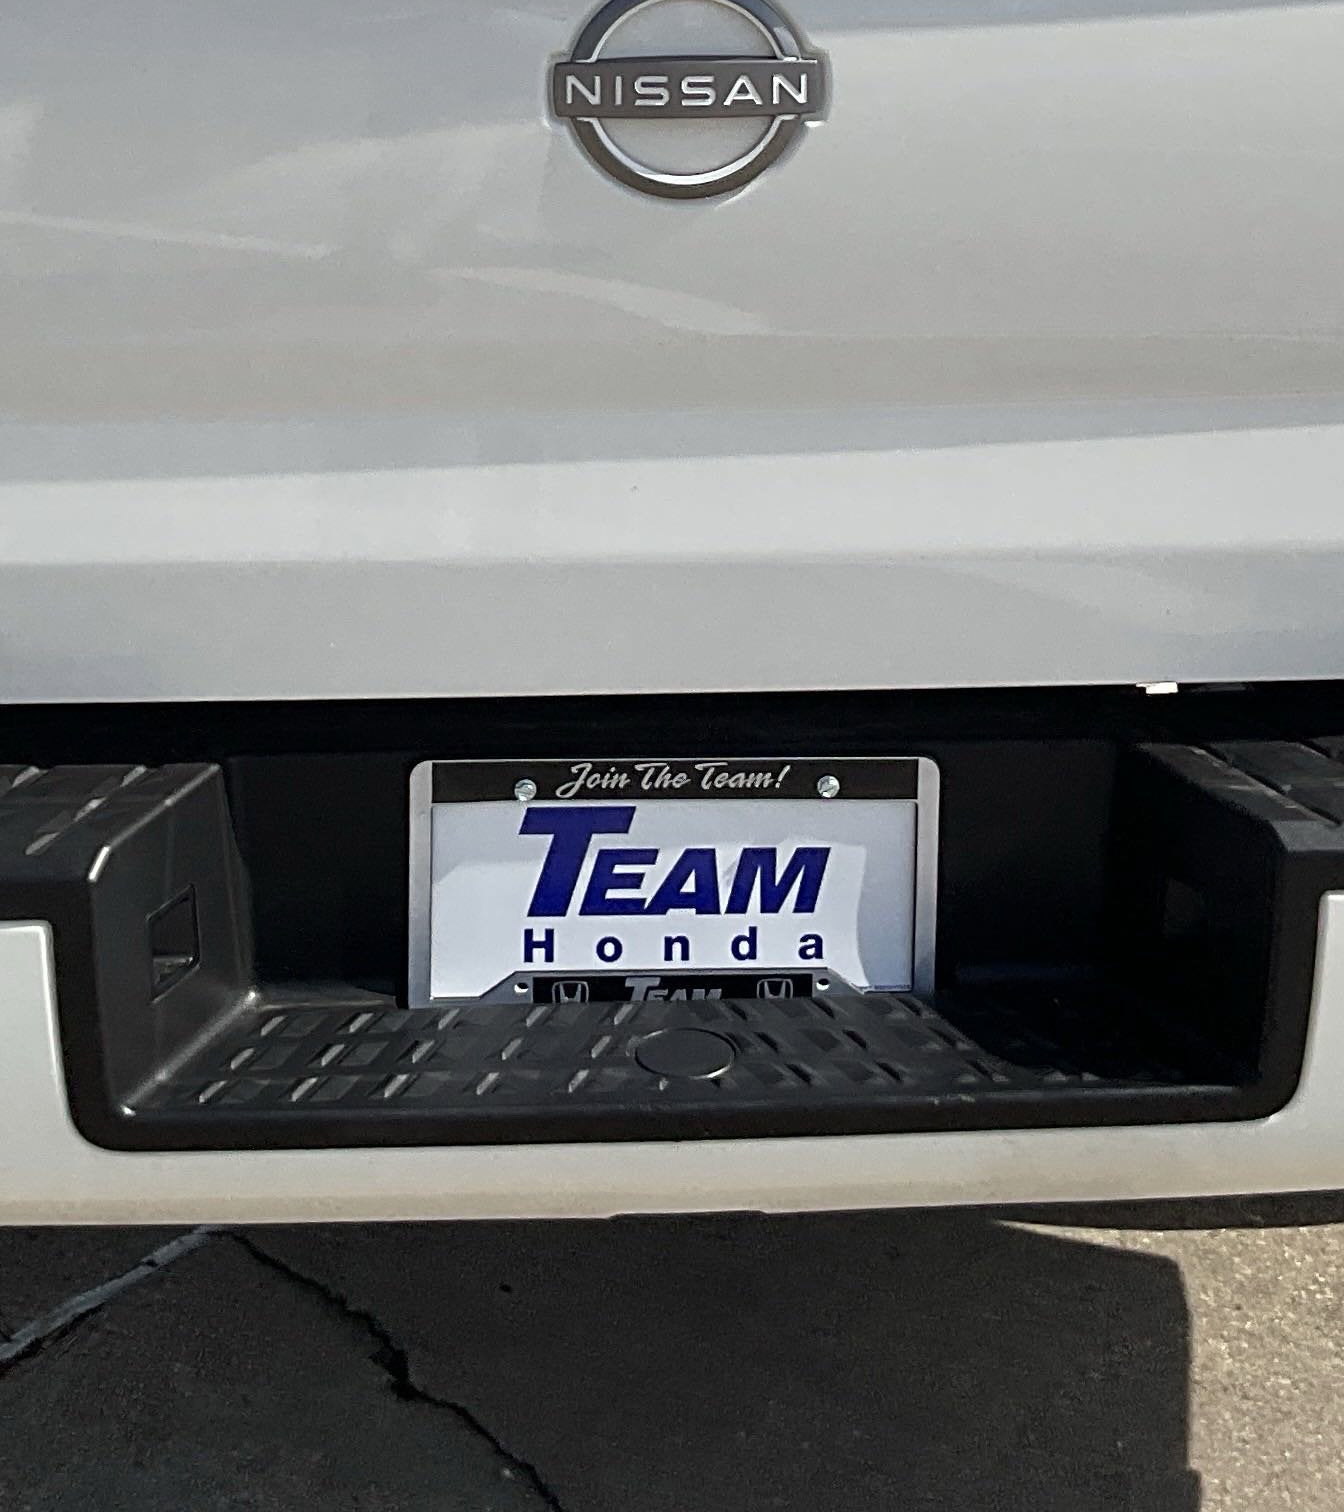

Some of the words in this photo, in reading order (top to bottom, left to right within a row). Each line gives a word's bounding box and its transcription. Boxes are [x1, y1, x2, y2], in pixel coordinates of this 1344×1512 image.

[565, 73, 807, 106] NISSAN
[555, 762, 631, 799] Join
[634, 762, 691, 790] The
[694, 761, 791, 790] Team!
[518, 806, 831, 917] TEAM
[523, 926, 824, 963] Honda
